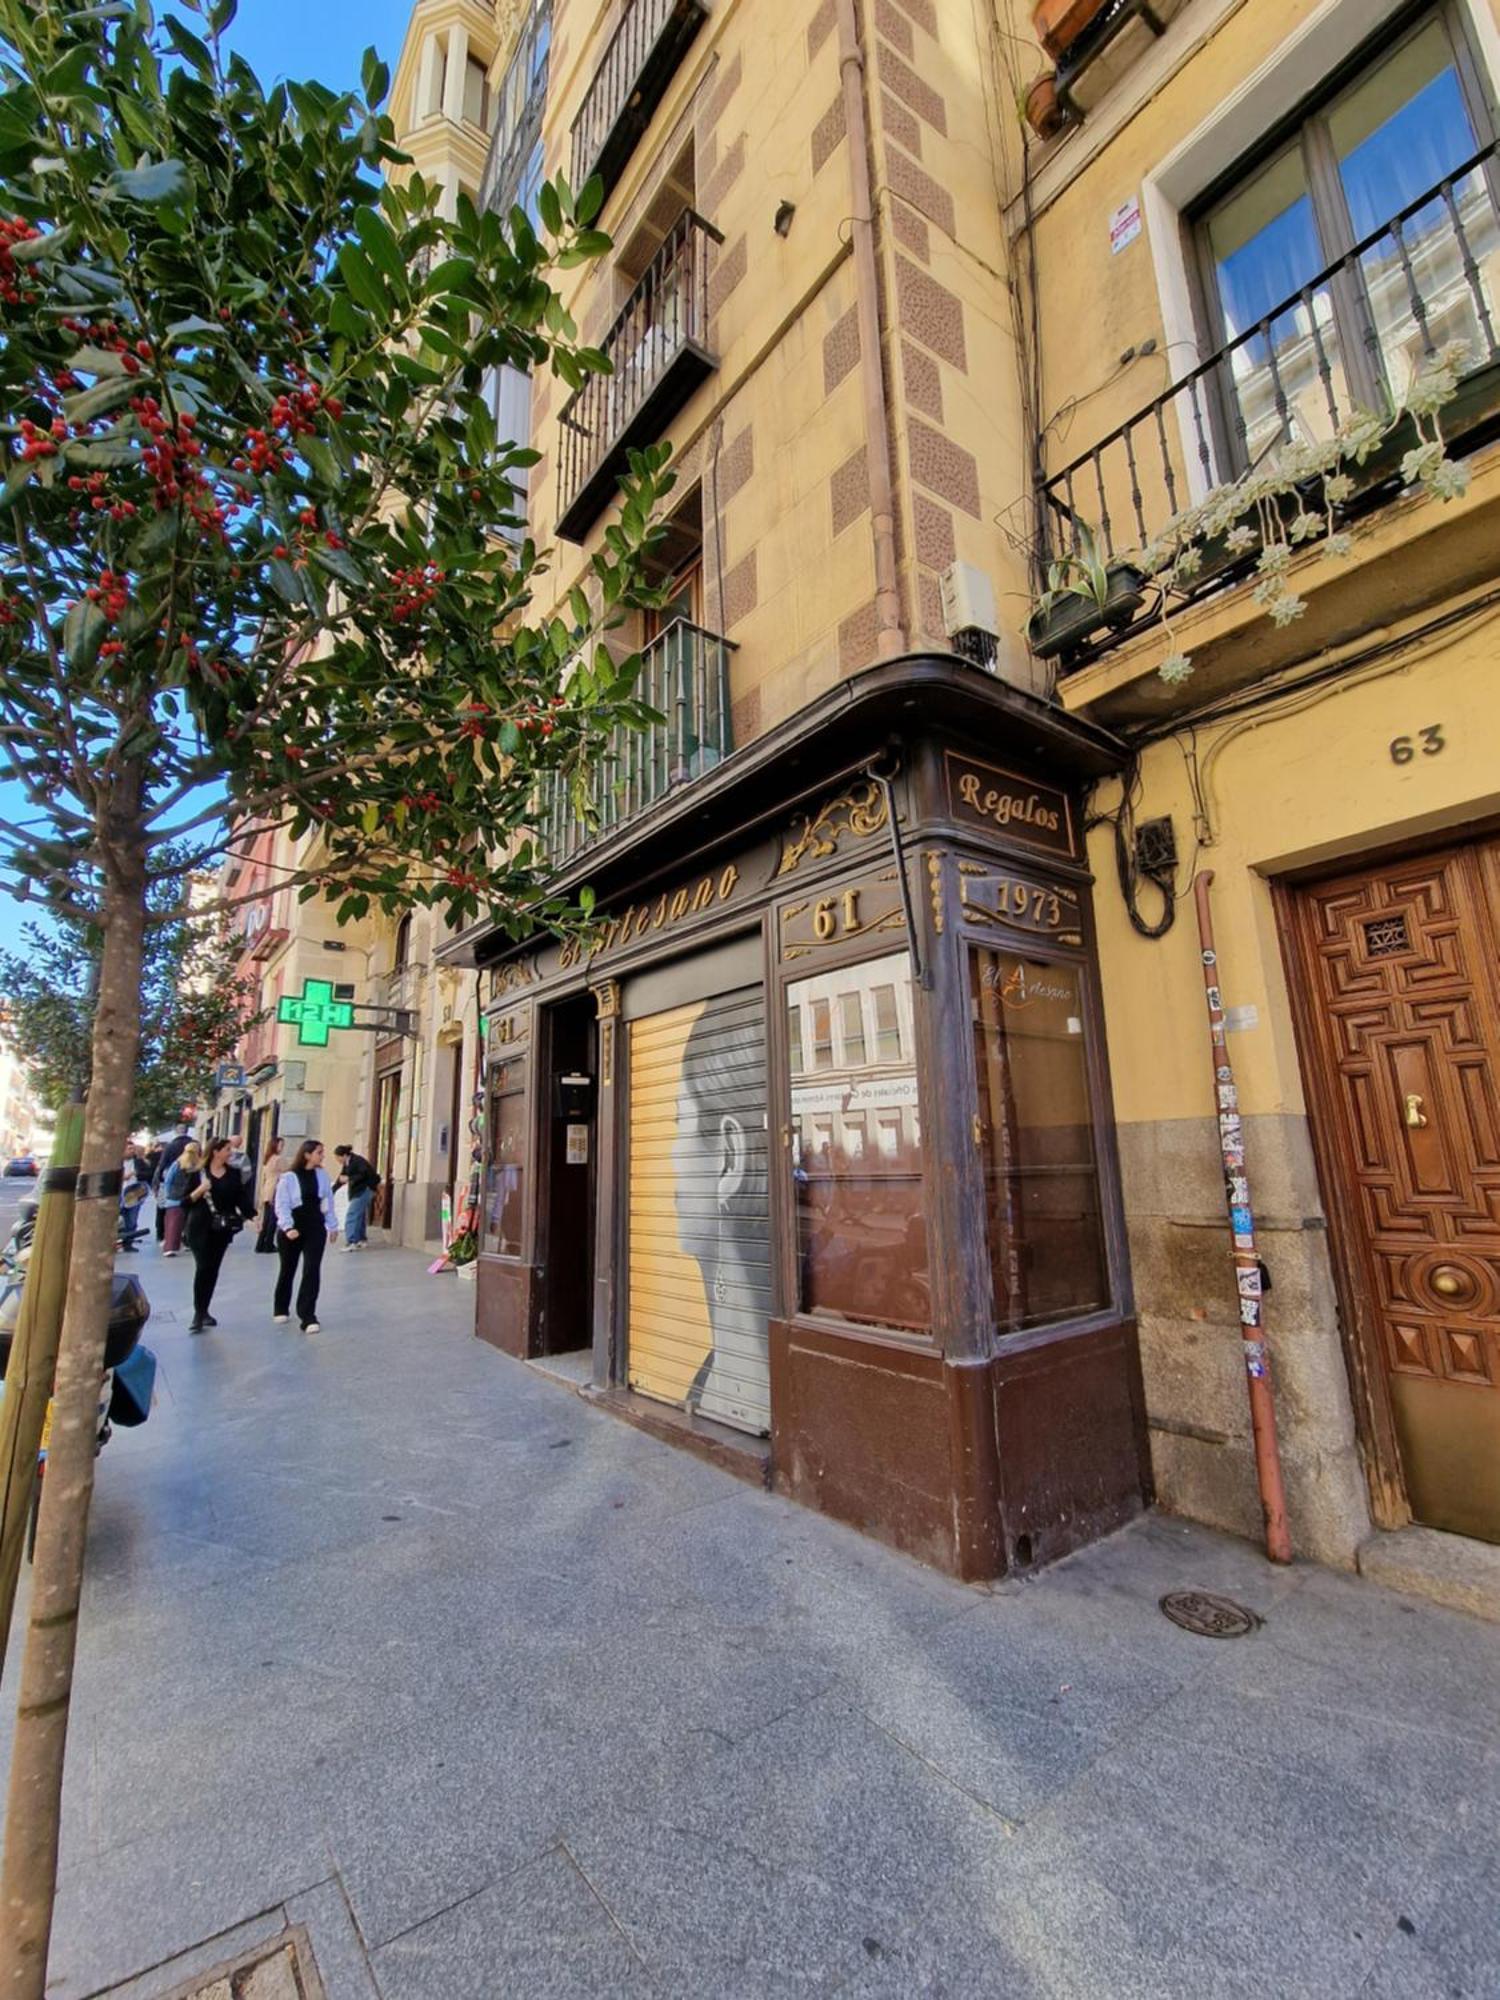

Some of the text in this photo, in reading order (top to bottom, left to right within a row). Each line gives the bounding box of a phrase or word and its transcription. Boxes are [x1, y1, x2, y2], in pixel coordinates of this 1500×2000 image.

[1390, 724, 1445, 766] 63
[959, 773, 1060, 831] Regalos
[814, 889, 861, 940] 61
[997, 881, 1061, 926] 1973
[498, 1017, 515, 1043] 61
